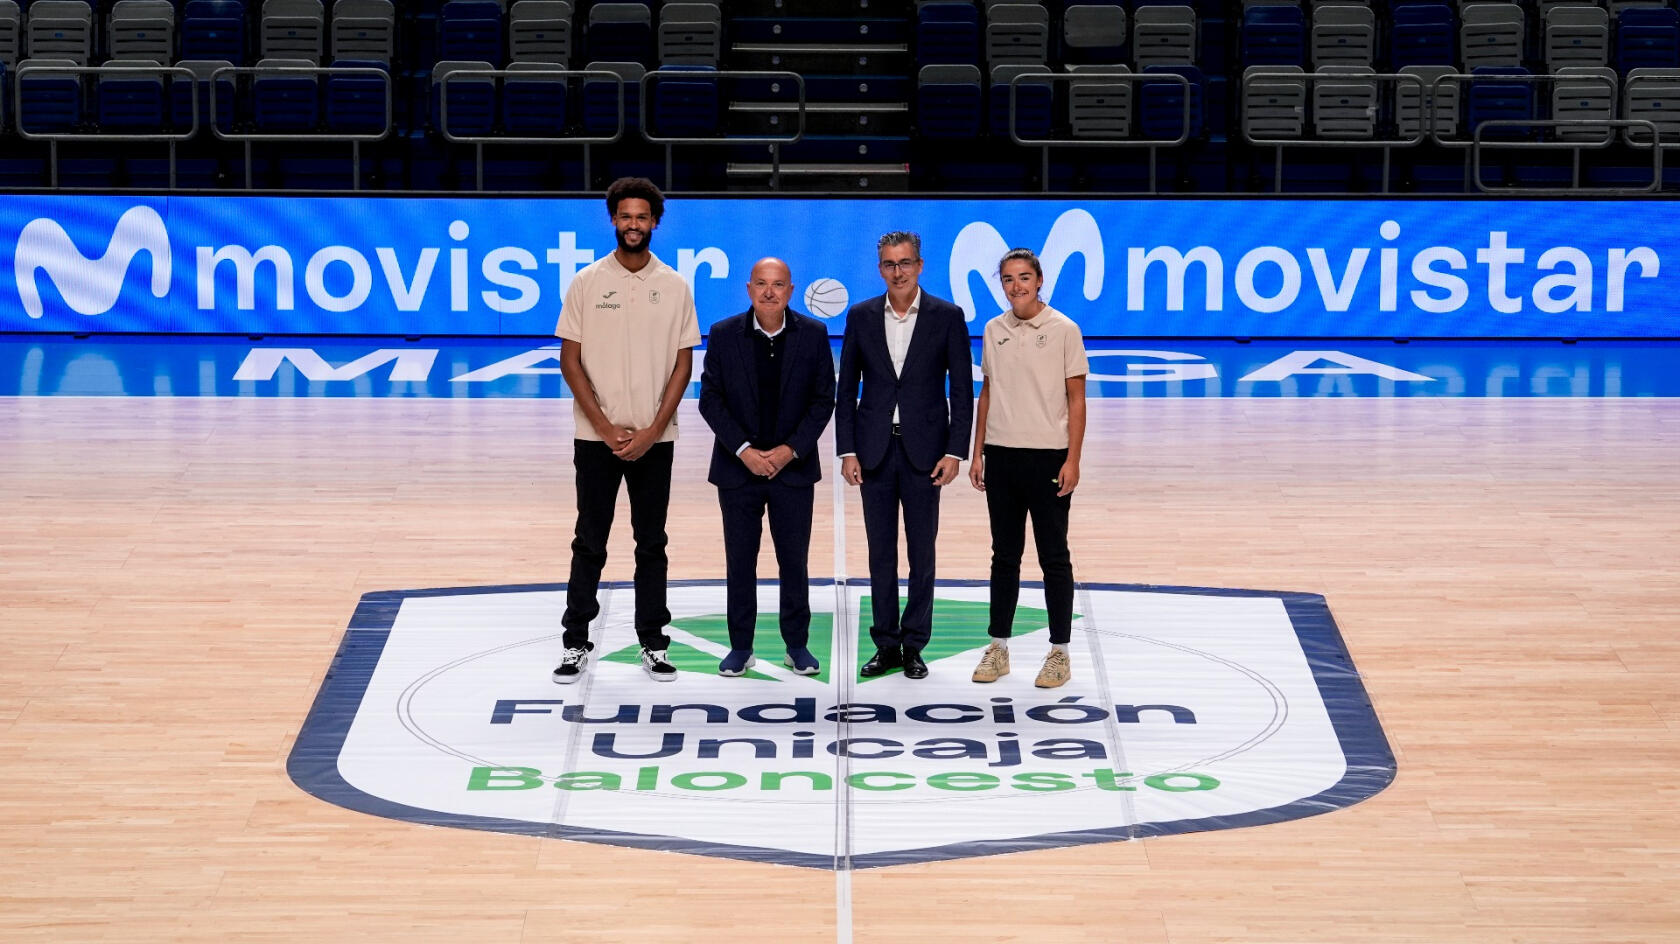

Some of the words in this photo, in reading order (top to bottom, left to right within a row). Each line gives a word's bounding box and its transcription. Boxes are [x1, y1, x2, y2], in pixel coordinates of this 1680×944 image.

[196, 220, 729, 313] movistr
[1127, 220, 1661, 314] movistar
[490, 696, 1197, 725] Fundación
[592, 731, 1107, 767] Unicaja
[467, 765, 1221, 792] Baloncesto
